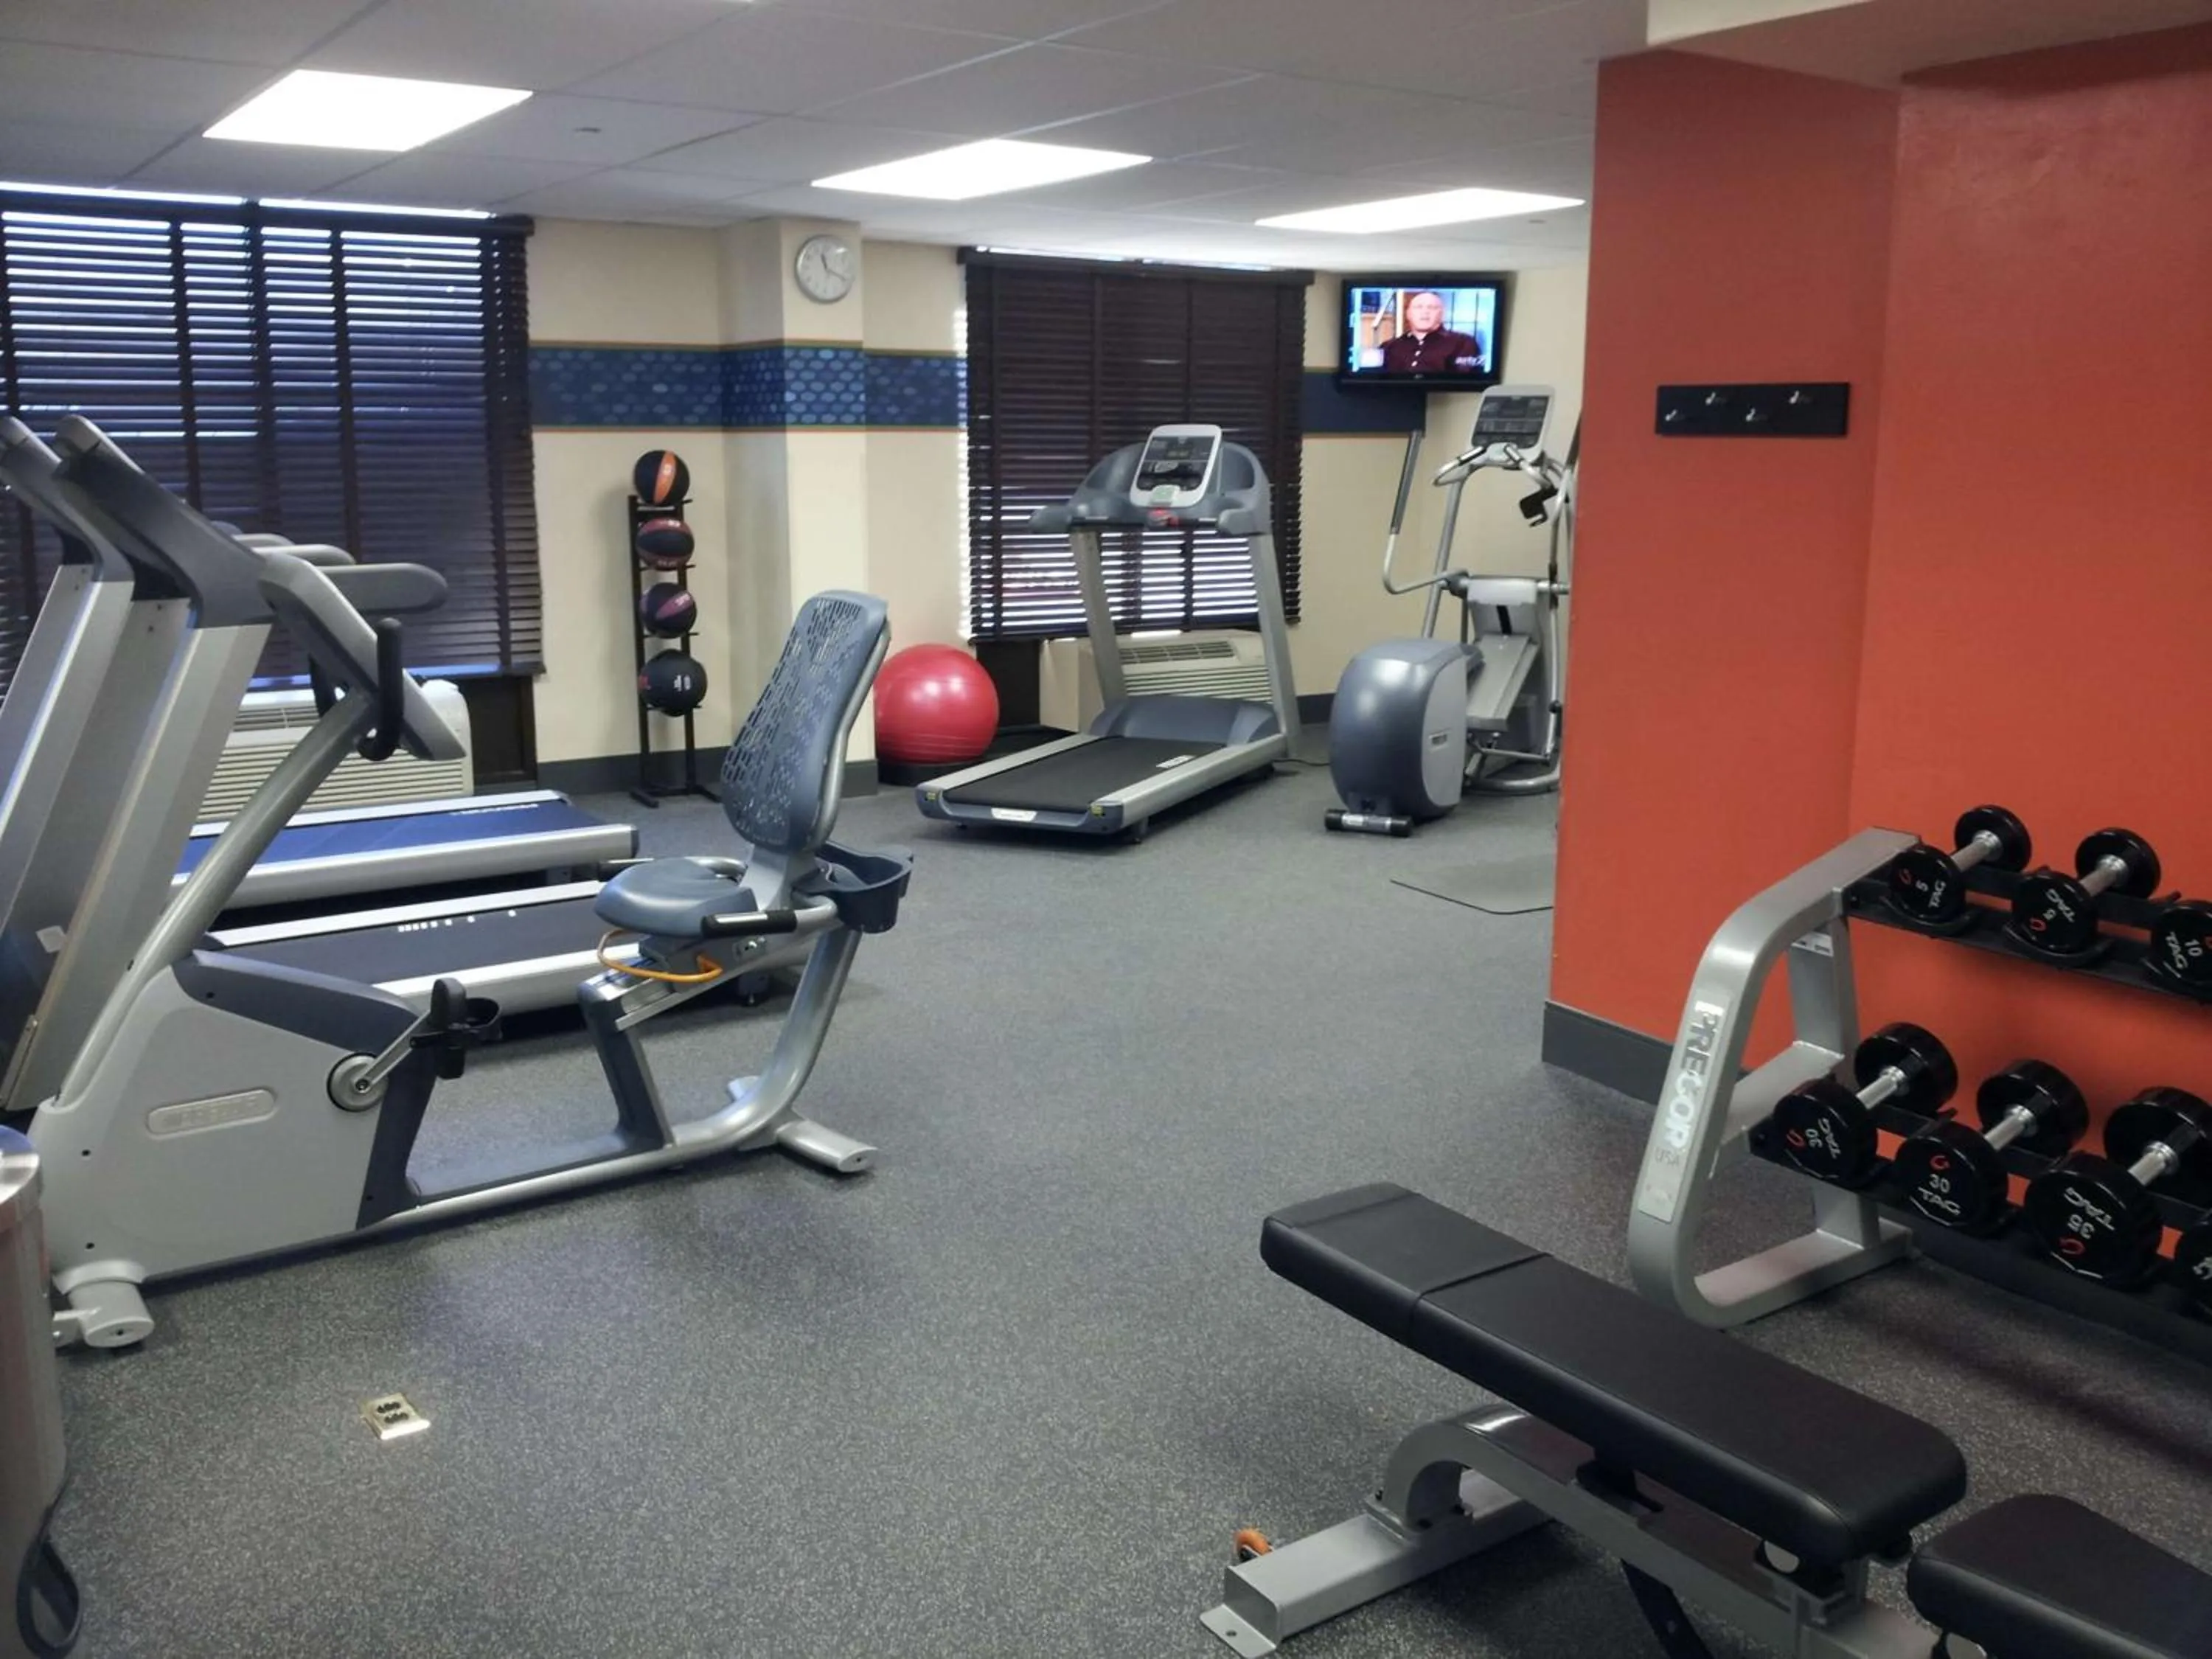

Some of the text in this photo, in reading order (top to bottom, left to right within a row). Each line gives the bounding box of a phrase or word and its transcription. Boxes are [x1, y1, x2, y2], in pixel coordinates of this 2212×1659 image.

[1928, 880, 1947, 908] TAG
[2046, 888, 2076, 923] TAG
[2166, 931, 2188, 970] TAG
[2185, 939, 2203, 956] 10
[1663, 1000, 1724, 1149] PRECOR
[1818, 1118, 1841, 1159] TAG
[1929, 1173, 1950, 1193] 30
[1918, 1187, 1961, 1215] TAG
[2064, 1186, 2115, 1231] TAG
[2067, 1214, 2095, 1239] 35
